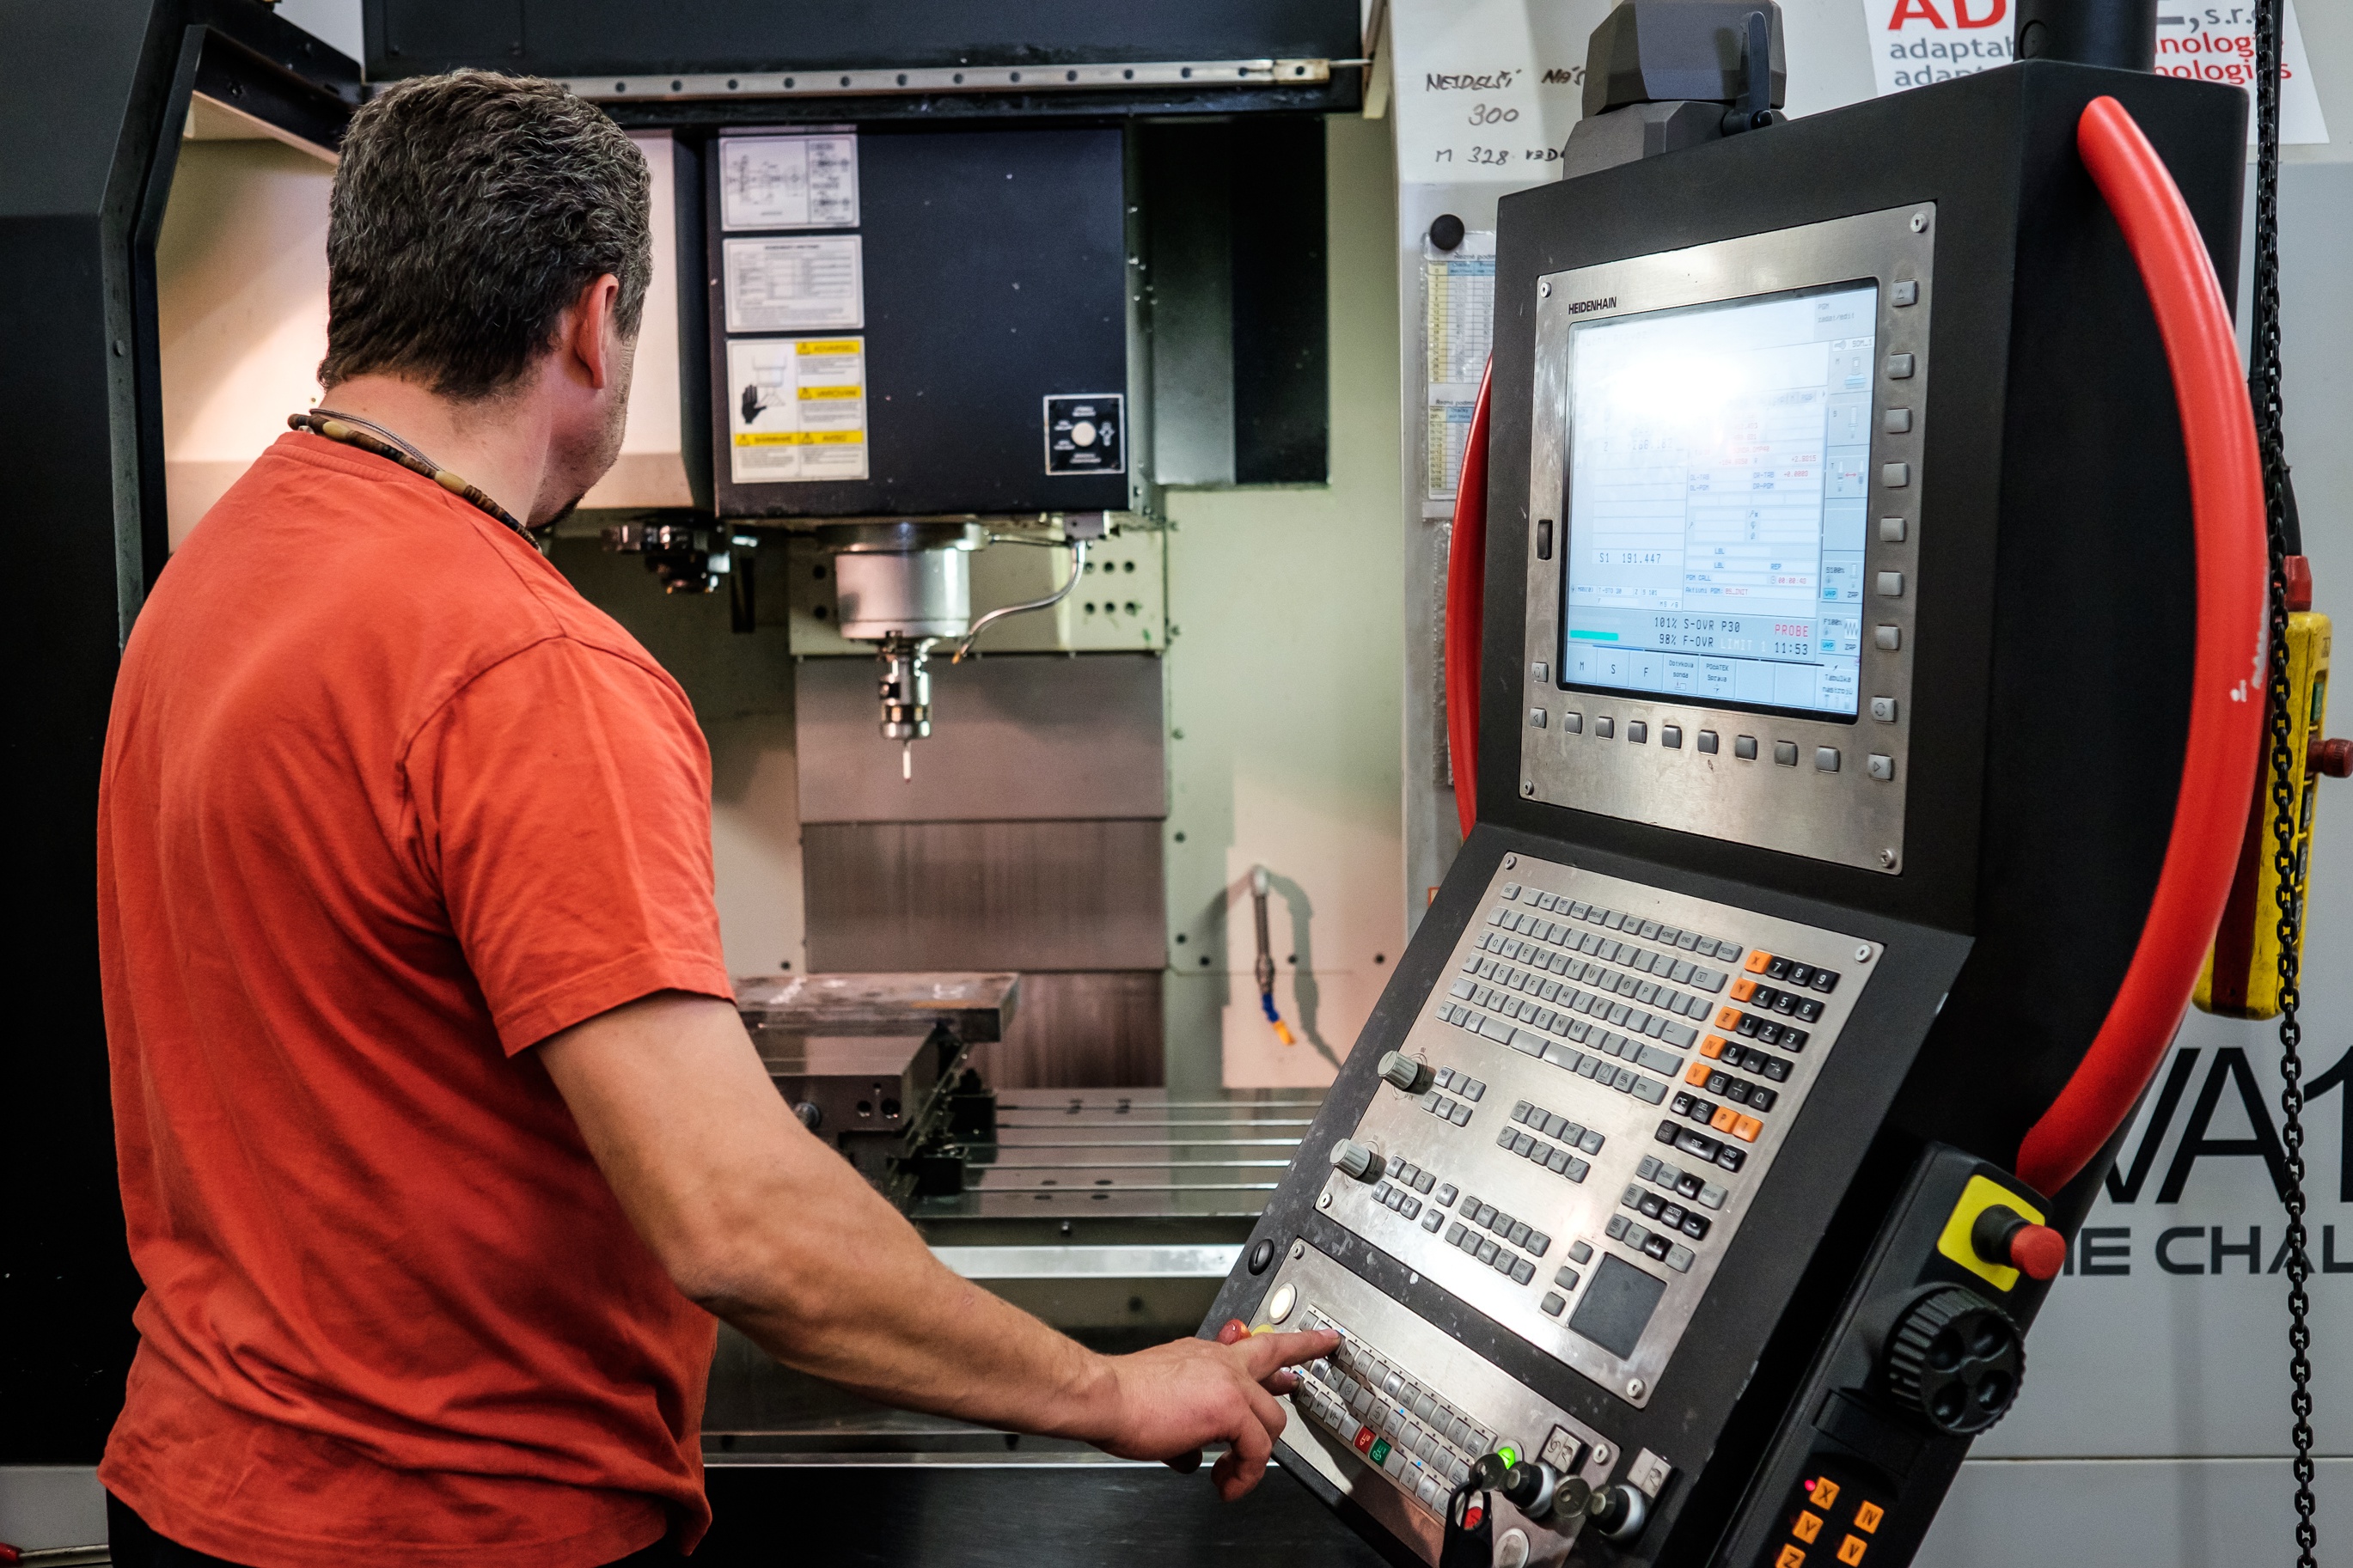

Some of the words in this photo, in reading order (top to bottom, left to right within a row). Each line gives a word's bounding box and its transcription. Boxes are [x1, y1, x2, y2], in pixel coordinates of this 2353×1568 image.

[1468, 103, 1519, 126] 300
[1435, 149, 1452, 162] M
[1467, 146, 1510, 166] 328
[1568, 296, 1617, 314] HEIDENHAIN
[1599, 552, 1610, 563] S1
[1622, 552, 1661, 564] 191.447
[1653, 617, 1678, 629] 101%
[1684, 619, 1715, 631] S-OVR
[1721, 620, 1741, 633] P30
[1775, 624, 1810, 638] PROBE
[1659, 633, 1677, 646] 98%
[1683, 635, 1714, 649] F-OVR
[1774, 642, 1809, 656] 11:53
[1610, 664, 1617, 675] S
[1643, 667, 1649, 678] F
[1661, 930, 1675, 939] HOME
[1492, 938, 1500, 948] Q
[1523, 949, 1529, 957] E
[1556, 959, 1562, 967] T
[1572, 964, 1579, 973] Y
[1588, 969, 1596, 978] U
[1607, 975, 1611, 984] I
[1623, 981, 1631, 990] O
[1641, 986, 1649, 996] P
[1751, 956, 1760, 965] X
[1773, 961, 1782, 973] 7
[1794, 967, 1804, 979] 8
[1818, 974, 1827, 985] 9
[1497, 969, 1504, 978] S
[1529, 979, 1536, 988] F
[1545, 985, 1552, 994] G
[1579, 996, 1585, 1005] J
[1596, 1003, 1604, 1012] K
[1614, 1010, 1619, 1019] L
[1738, 984, 1746, 993] Y
[1758, 991, 1767, 1000] 4
[1779, 997, 1789, 1008] 5
[1802, 1004, 1812, 1015] 6
[1507, 1002, 1514, 1010] C
[1525, 1007, 1531, 1016] V
[1539, 1013, 1546, 1022] B
[1557, 1020, 1564, 1028] N
[1721, 1012, 1730, 1022] Z
[1745, 1019, 1751, 1029] 1
[1763, 1026, 1773, 1037] 2
[1786, 1033, 1796, 1045] 3
[2064, 1227, 2131, 1277] E
[1818, 1486, 1833, 1504] X
[1806, 1520, 1817, 1536] Y
[1783, 1552, 1800, 1568] Z
[1849, 1544, 1861, 1559] V
